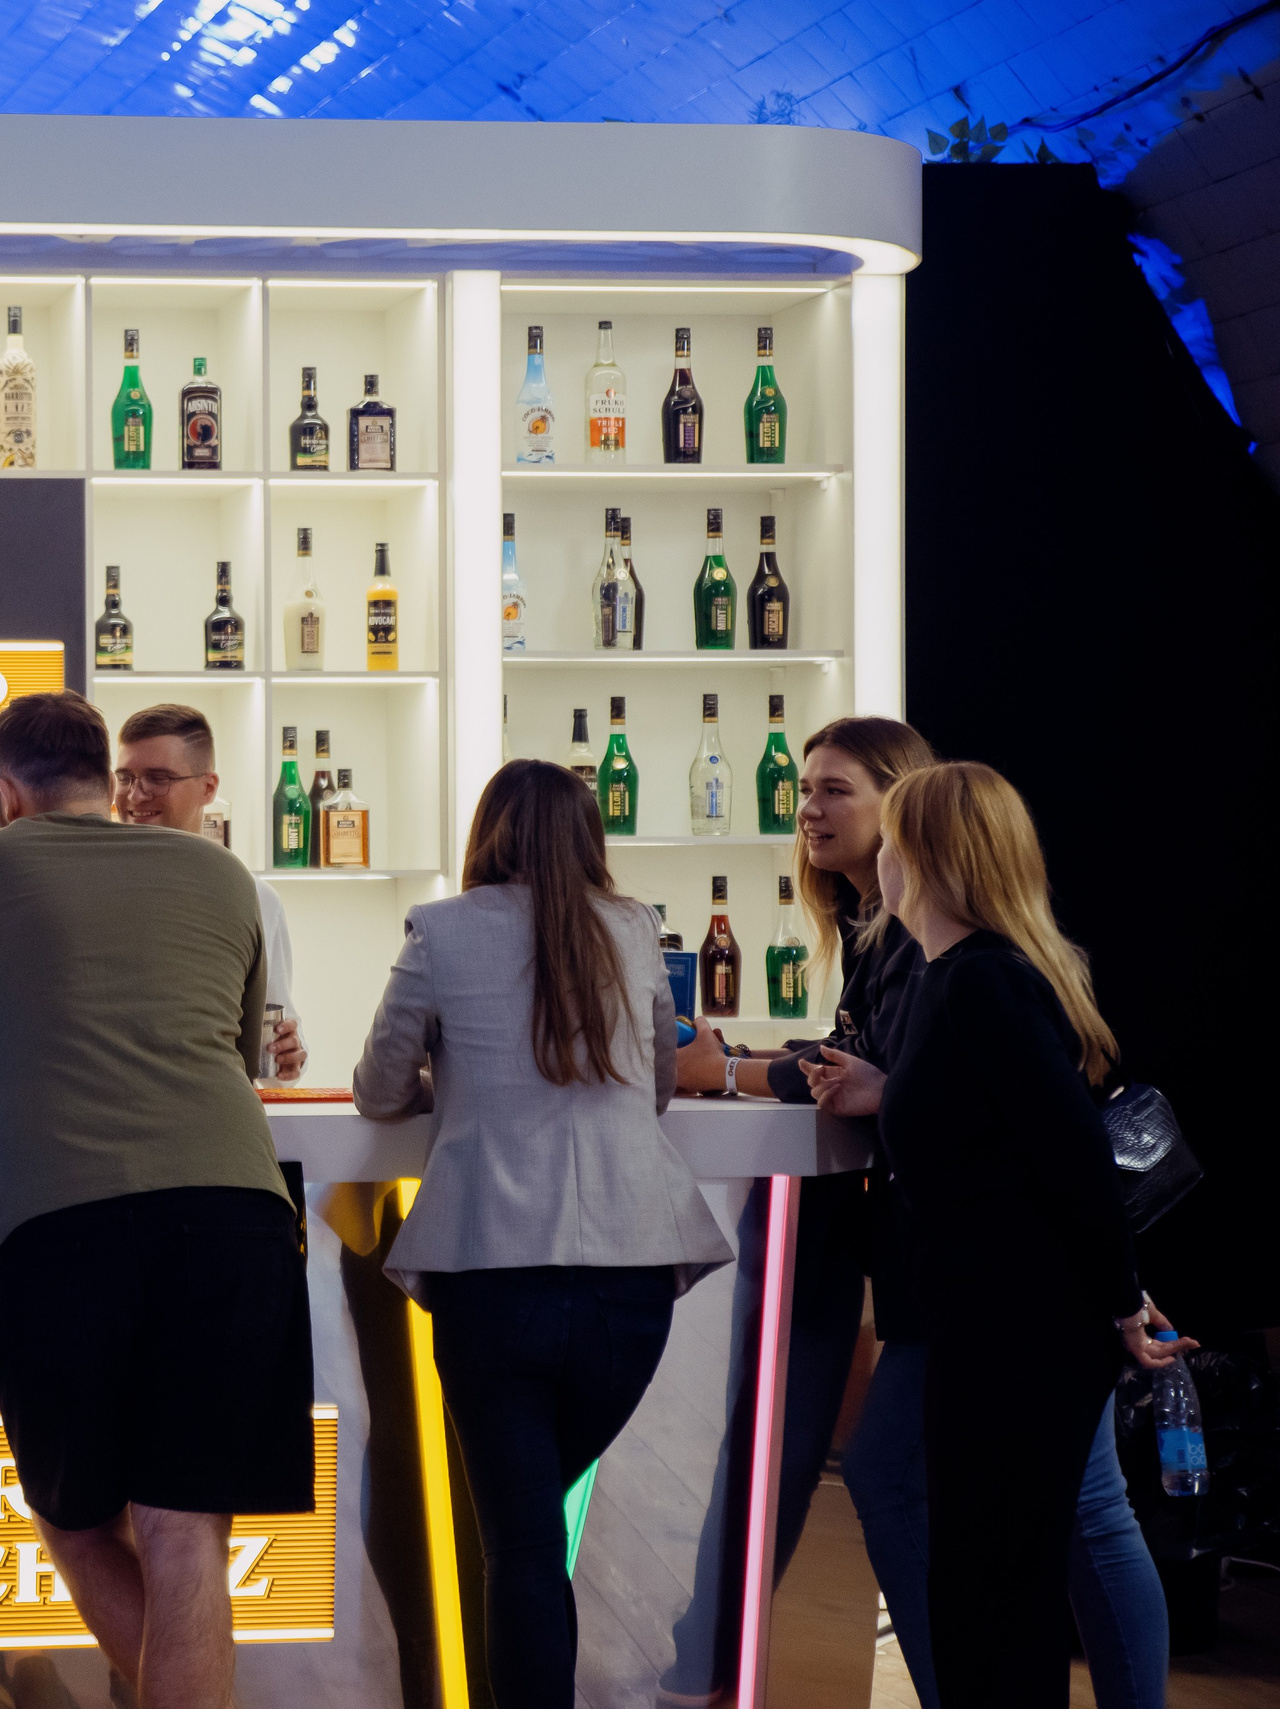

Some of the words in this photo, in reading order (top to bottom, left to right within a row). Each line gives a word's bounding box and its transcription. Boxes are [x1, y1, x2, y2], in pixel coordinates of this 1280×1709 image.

[717, 609, 726, 630] MINT
[613, 791, 621, 816] MELON
[289, 827, 299, 849] MINT
